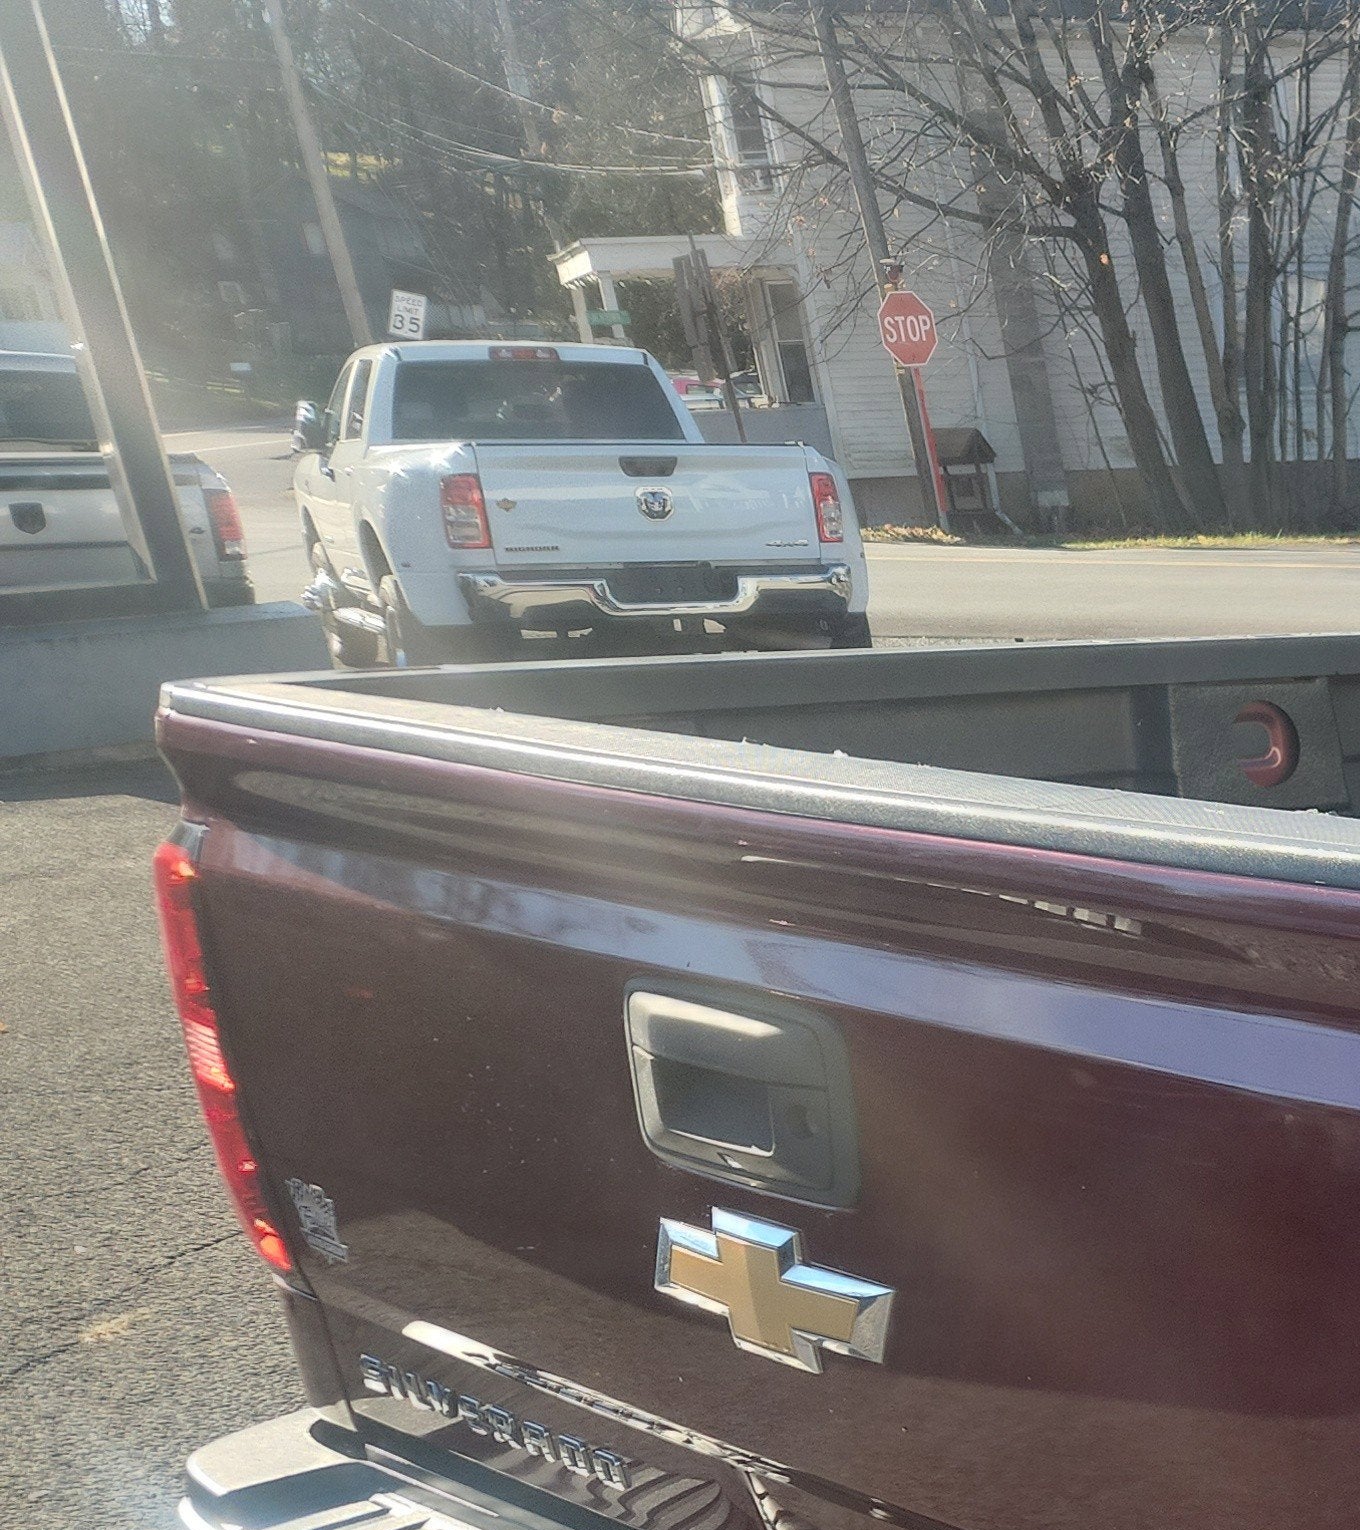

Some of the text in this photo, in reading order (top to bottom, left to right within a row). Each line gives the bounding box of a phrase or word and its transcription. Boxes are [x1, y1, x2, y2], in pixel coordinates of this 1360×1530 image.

[394, 295, 423, 307] SPEED
[392, 313, 421, 334] 35
[883, 315, 931, 343] STOP
[359, 1352, 633, 1493] SILVERADO
